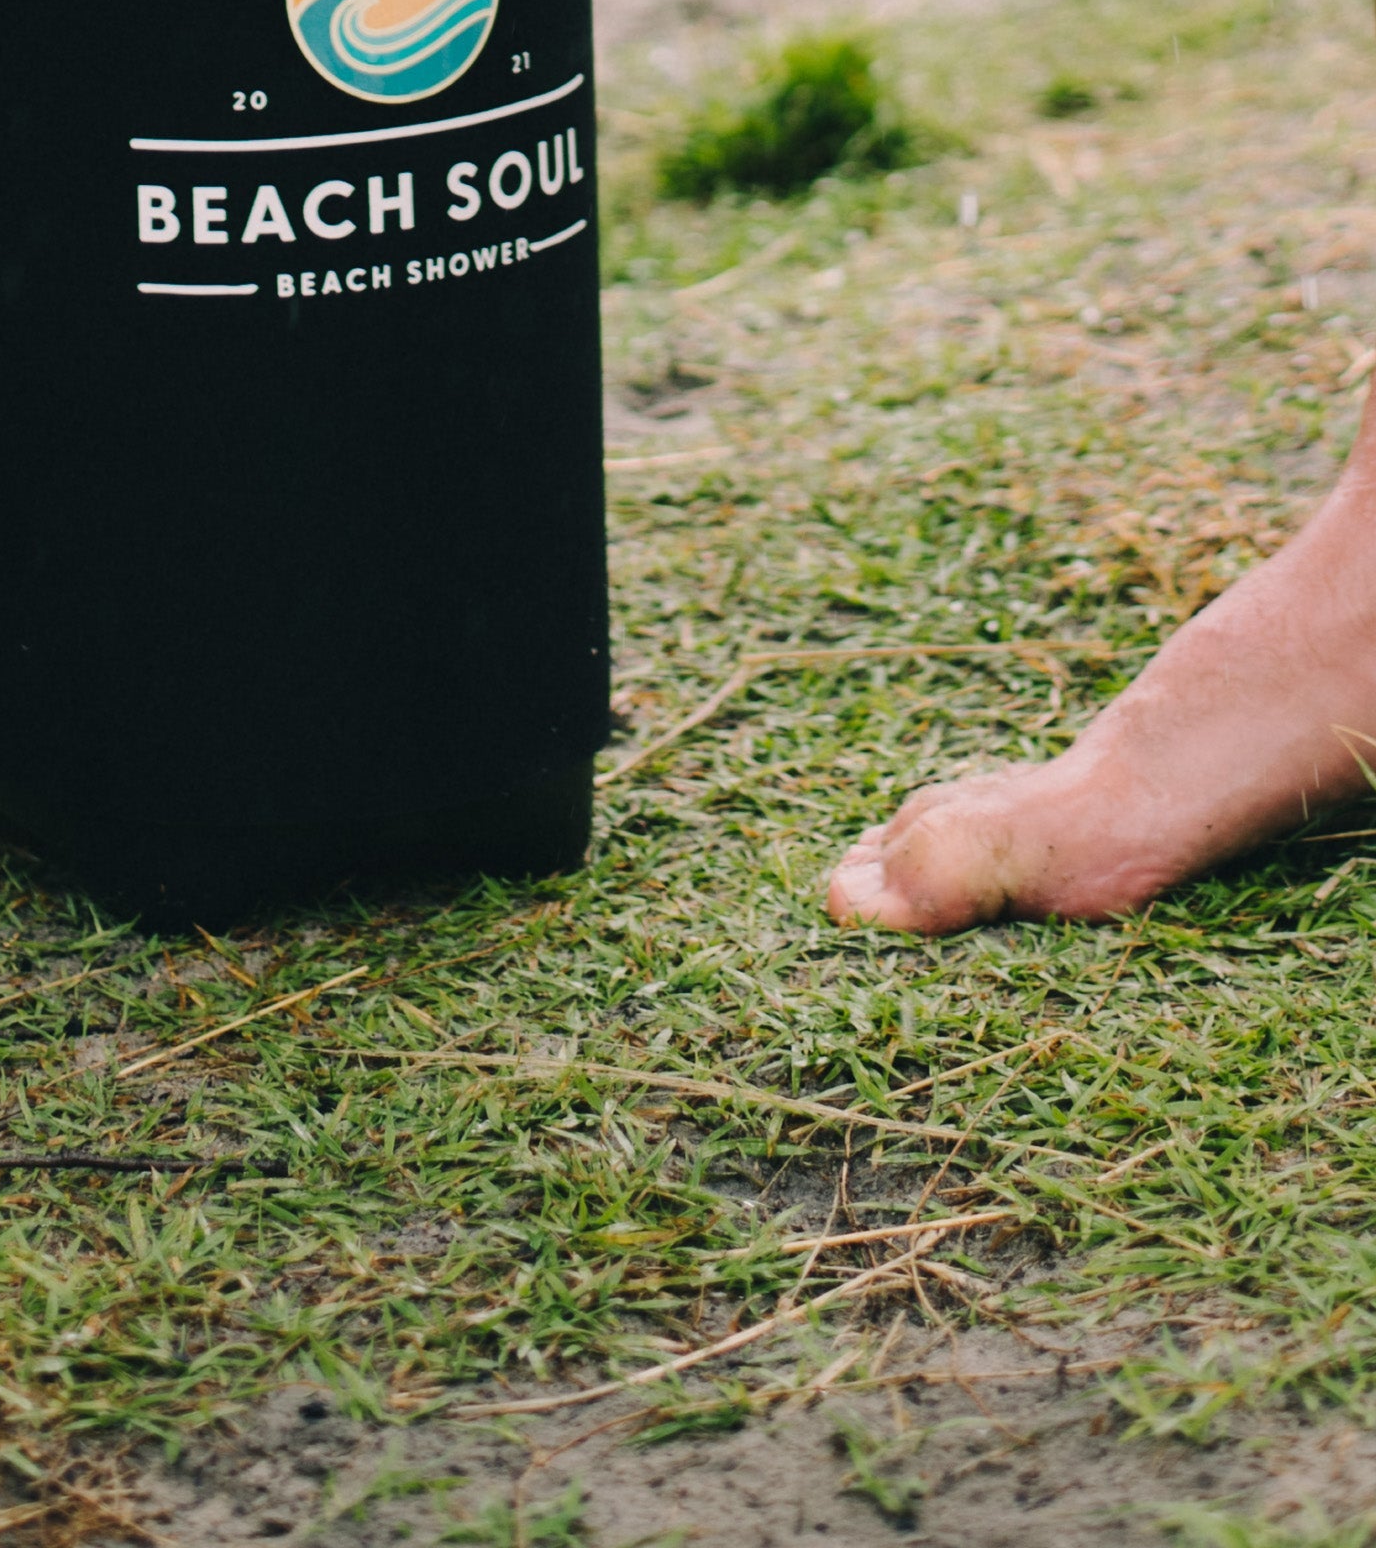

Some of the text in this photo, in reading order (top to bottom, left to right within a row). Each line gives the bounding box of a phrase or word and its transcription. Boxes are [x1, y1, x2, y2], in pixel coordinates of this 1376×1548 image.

[232, 50, 530, 111] 20 21
[136, 127, 584, 245] BEACH SOUL
[276, 237, 531, 298] BEACH SHOWER
